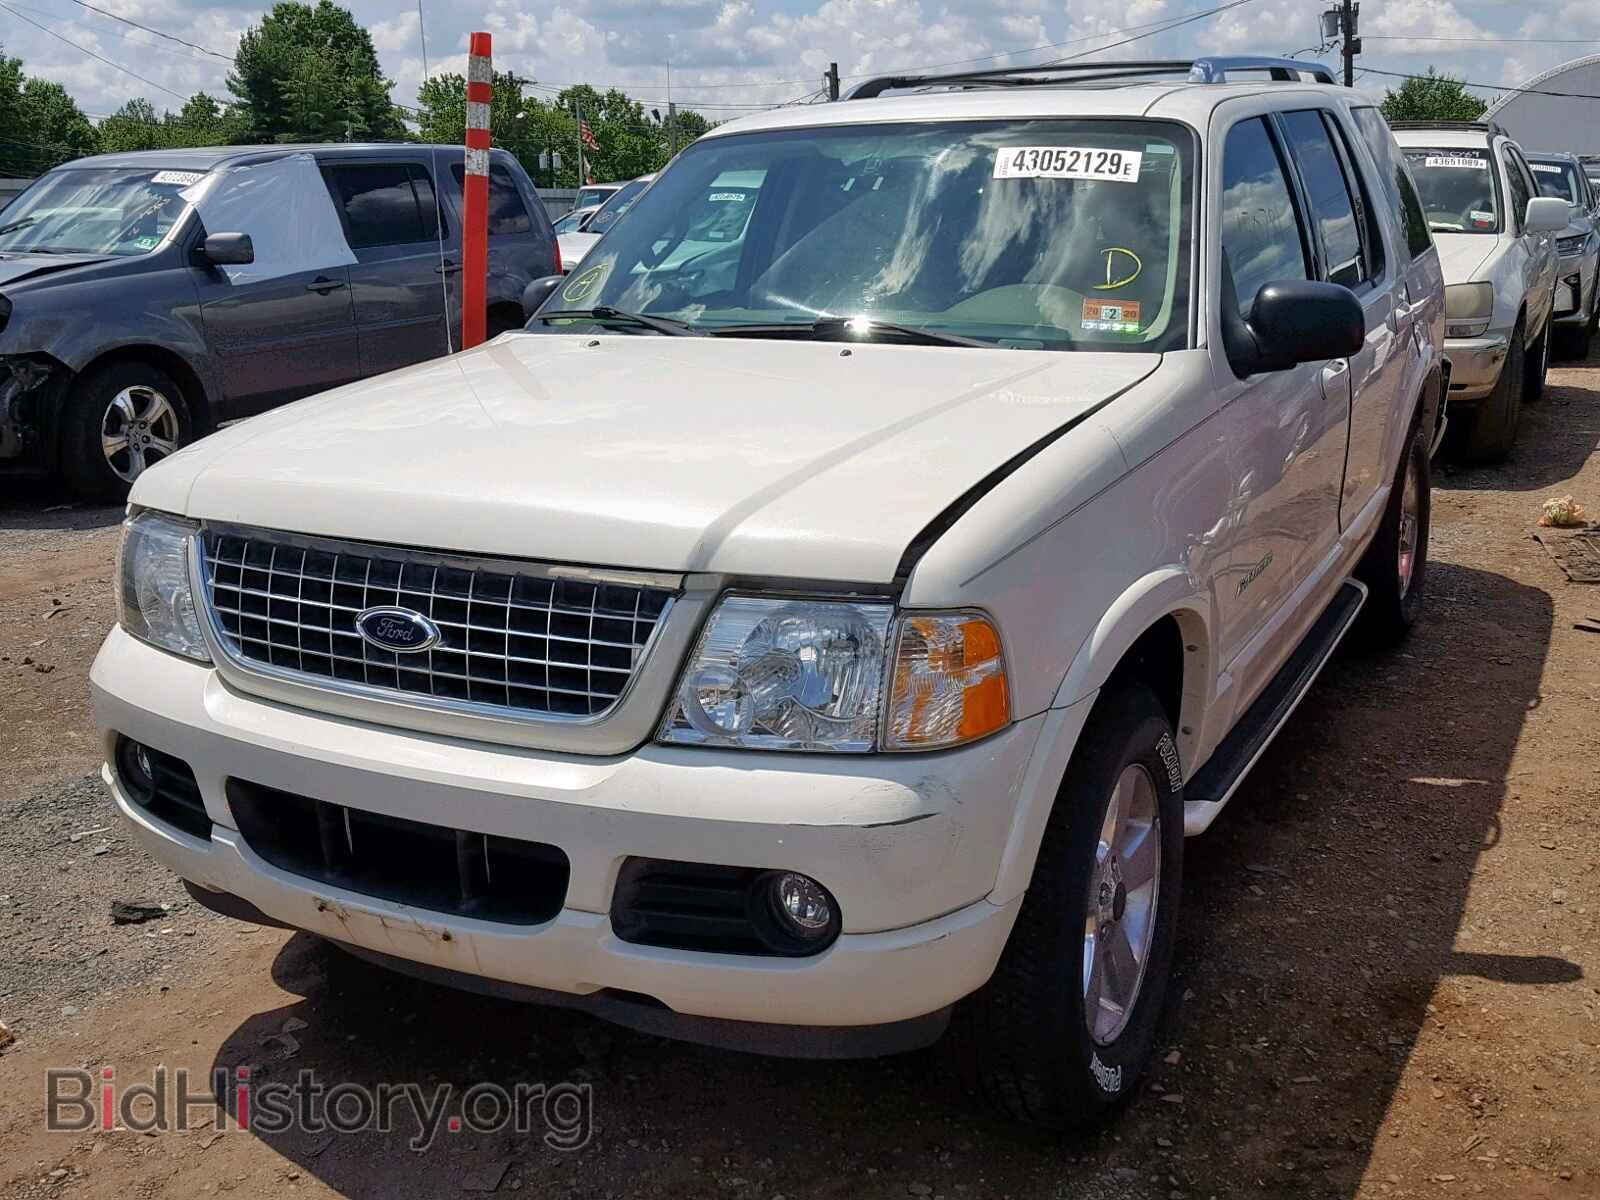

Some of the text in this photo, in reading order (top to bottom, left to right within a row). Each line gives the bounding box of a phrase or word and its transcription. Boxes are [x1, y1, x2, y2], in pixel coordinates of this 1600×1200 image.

[1093, 247, 1141, 289] D
[1123, 310, 1137, 319] 20
[376, 617, 414, 641] Ford
